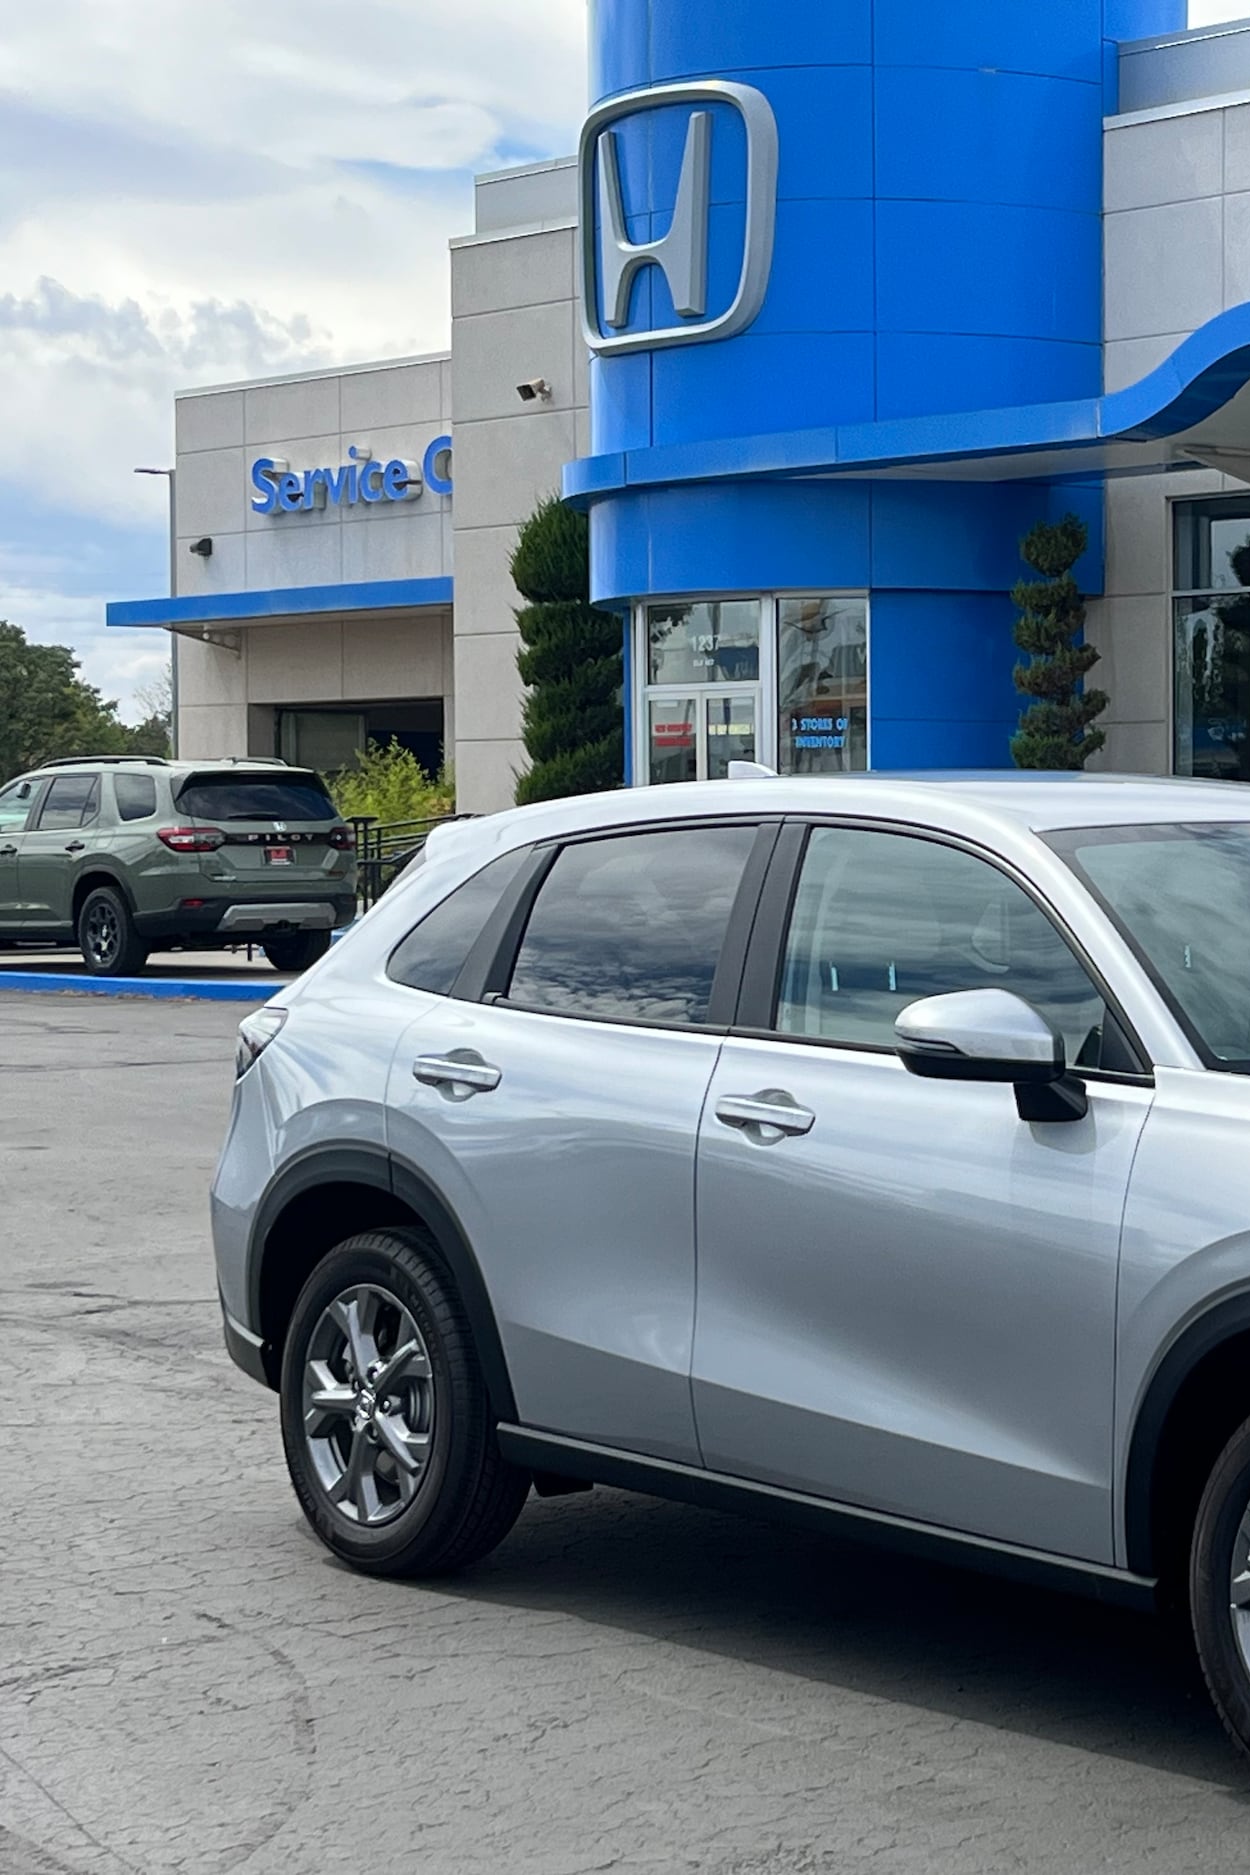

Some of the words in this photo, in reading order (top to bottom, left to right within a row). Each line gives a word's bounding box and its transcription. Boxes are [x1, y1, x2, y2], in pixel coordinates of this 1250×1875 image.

[251, 445, 418, 515] Service
[692, 634, 721, 652] 1237
[800, 717, 833, 731] STORES
[795, 735, 846, 749] INVENTORY
[248, 833, 314, 841] PILOT
